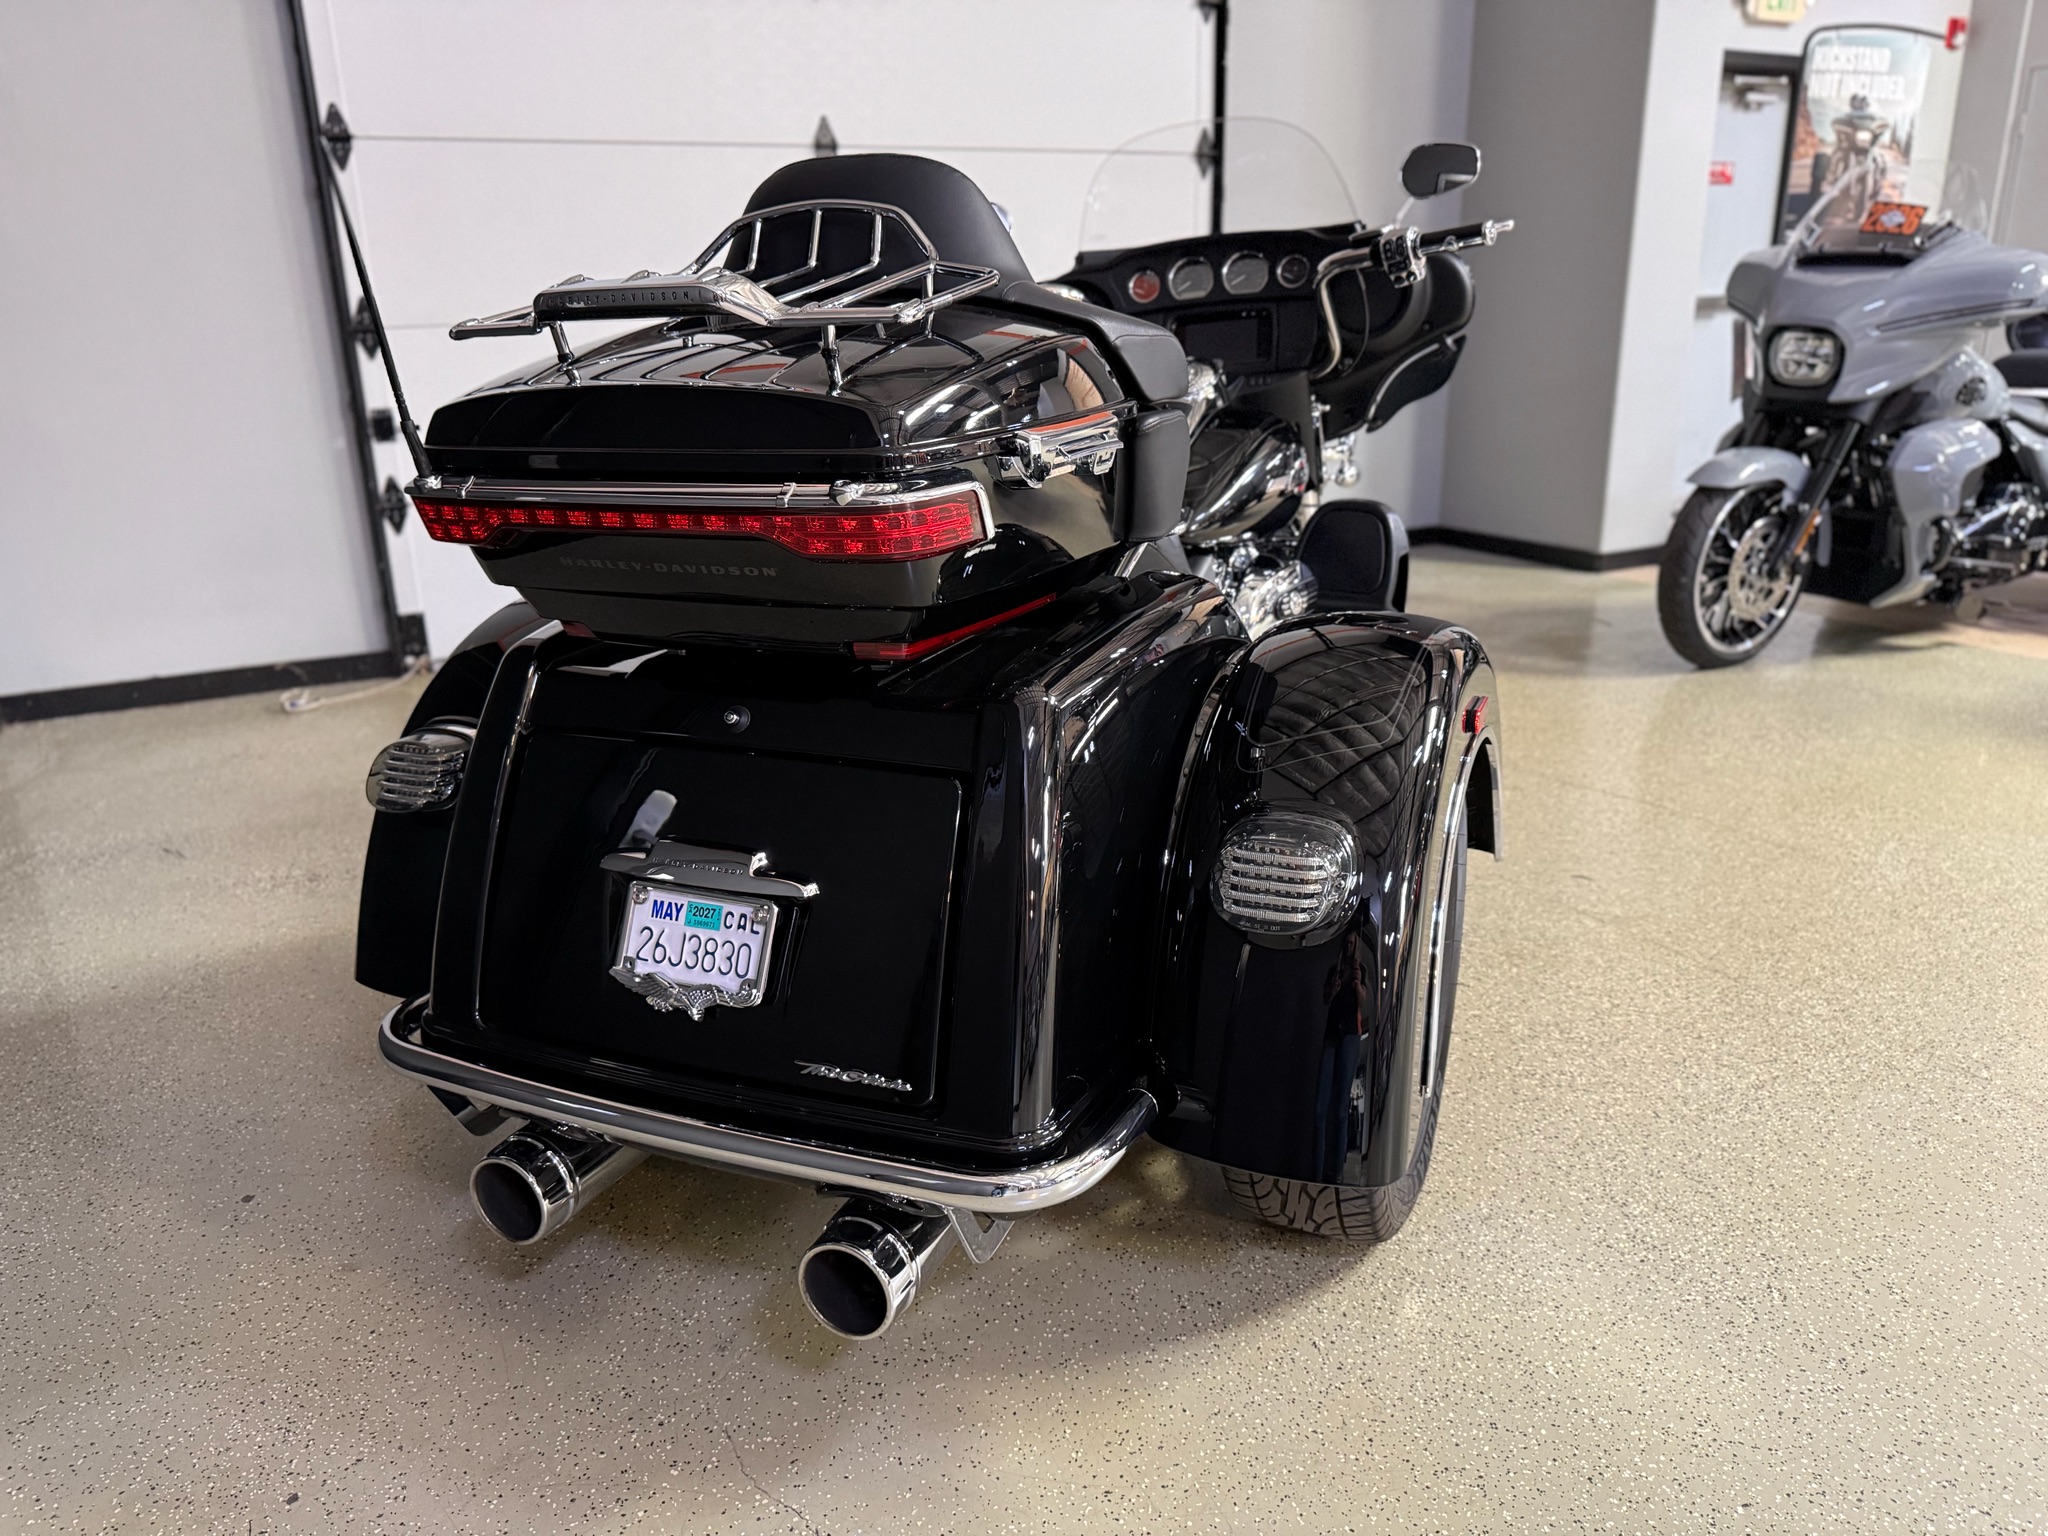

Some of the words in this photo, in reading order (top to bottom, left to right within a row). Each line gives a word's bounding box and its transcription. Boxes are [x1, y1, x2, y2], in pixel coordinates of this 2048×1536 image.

[559, 556, 776, 577] HARLEY-DAVIDSON
[652, 857, 744, 876] HRLEY-DAVIDSON
[651, 899, 685, 922] MAY
[692, 906, 716, 919] 2027
[723, 910, 760, 935] CAL
[636, 925, 752, 979] 26J3830
